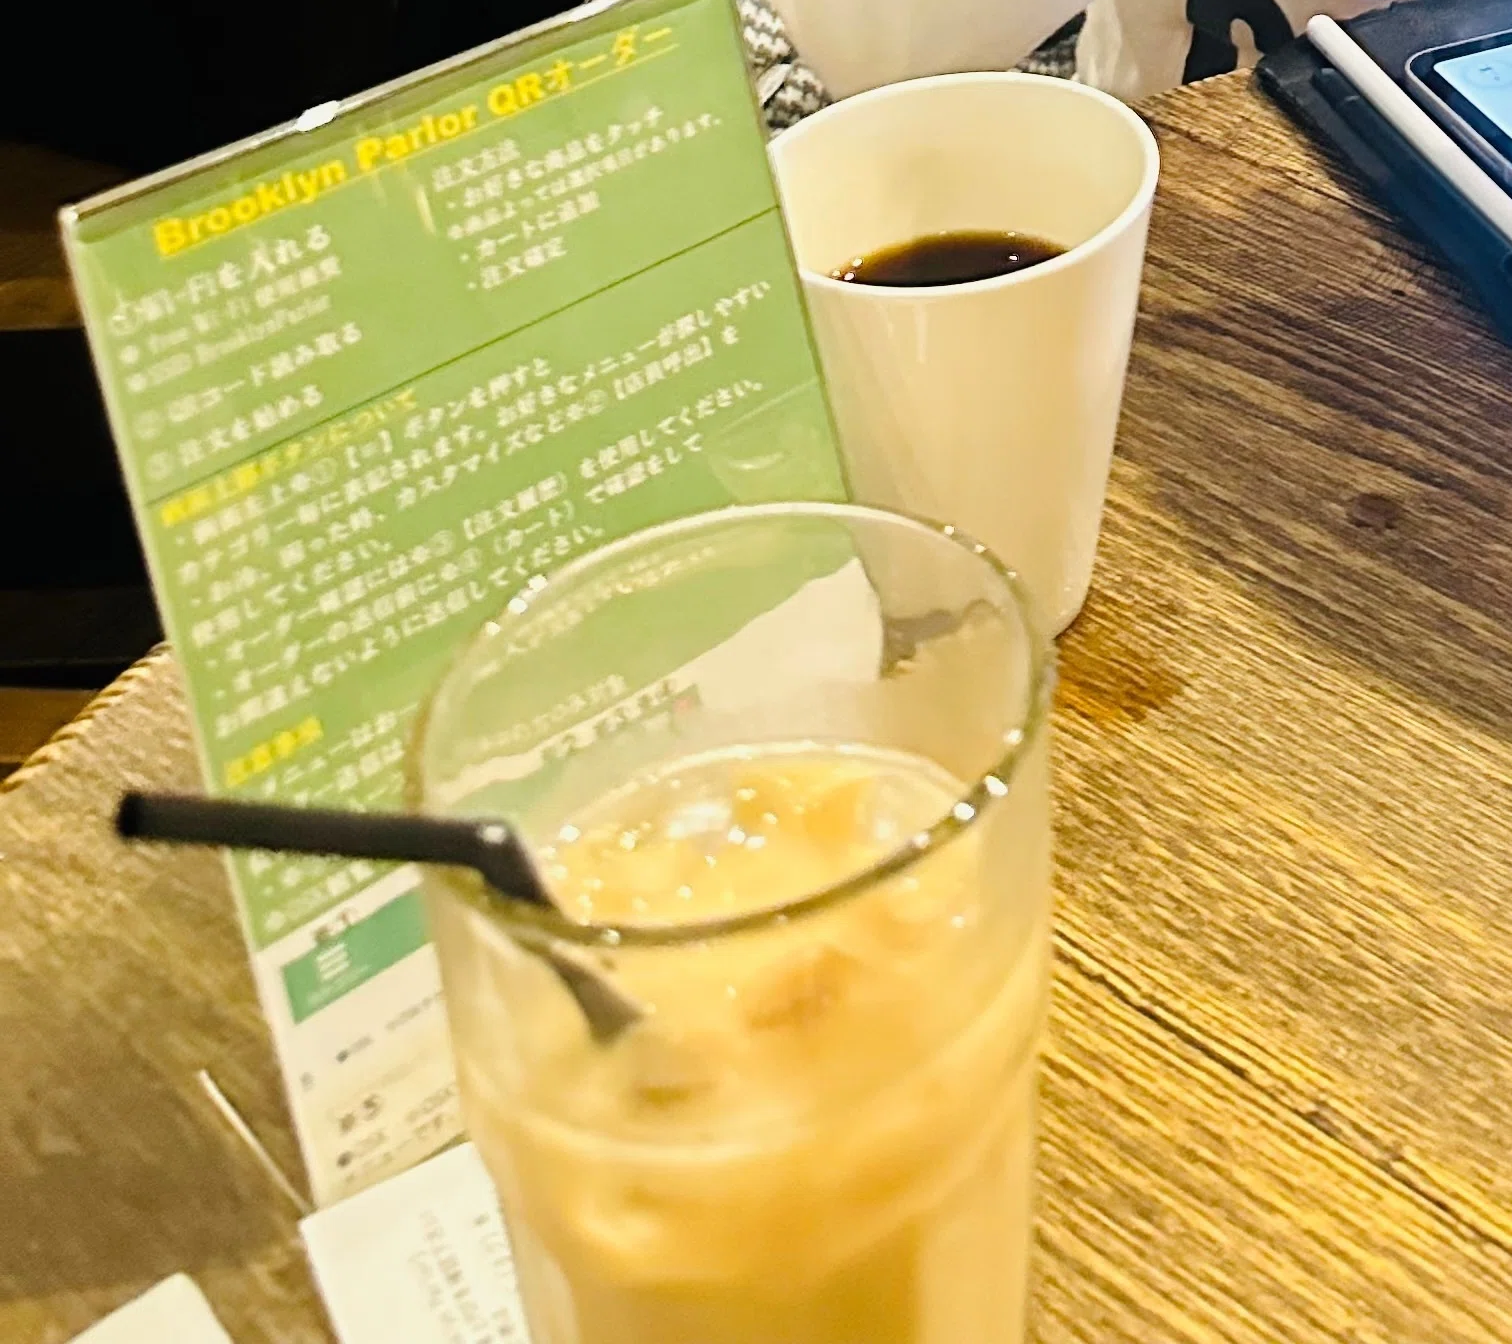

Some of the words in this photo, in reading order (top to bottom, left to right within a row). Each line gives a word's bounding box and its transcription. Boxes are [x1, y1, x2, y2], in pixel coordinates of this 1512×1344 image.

[152, 156, 349, 264] Brooklyn
[352, 102, 481, 176] Parlor
[484, 24, 675, 121] QRオーダー
